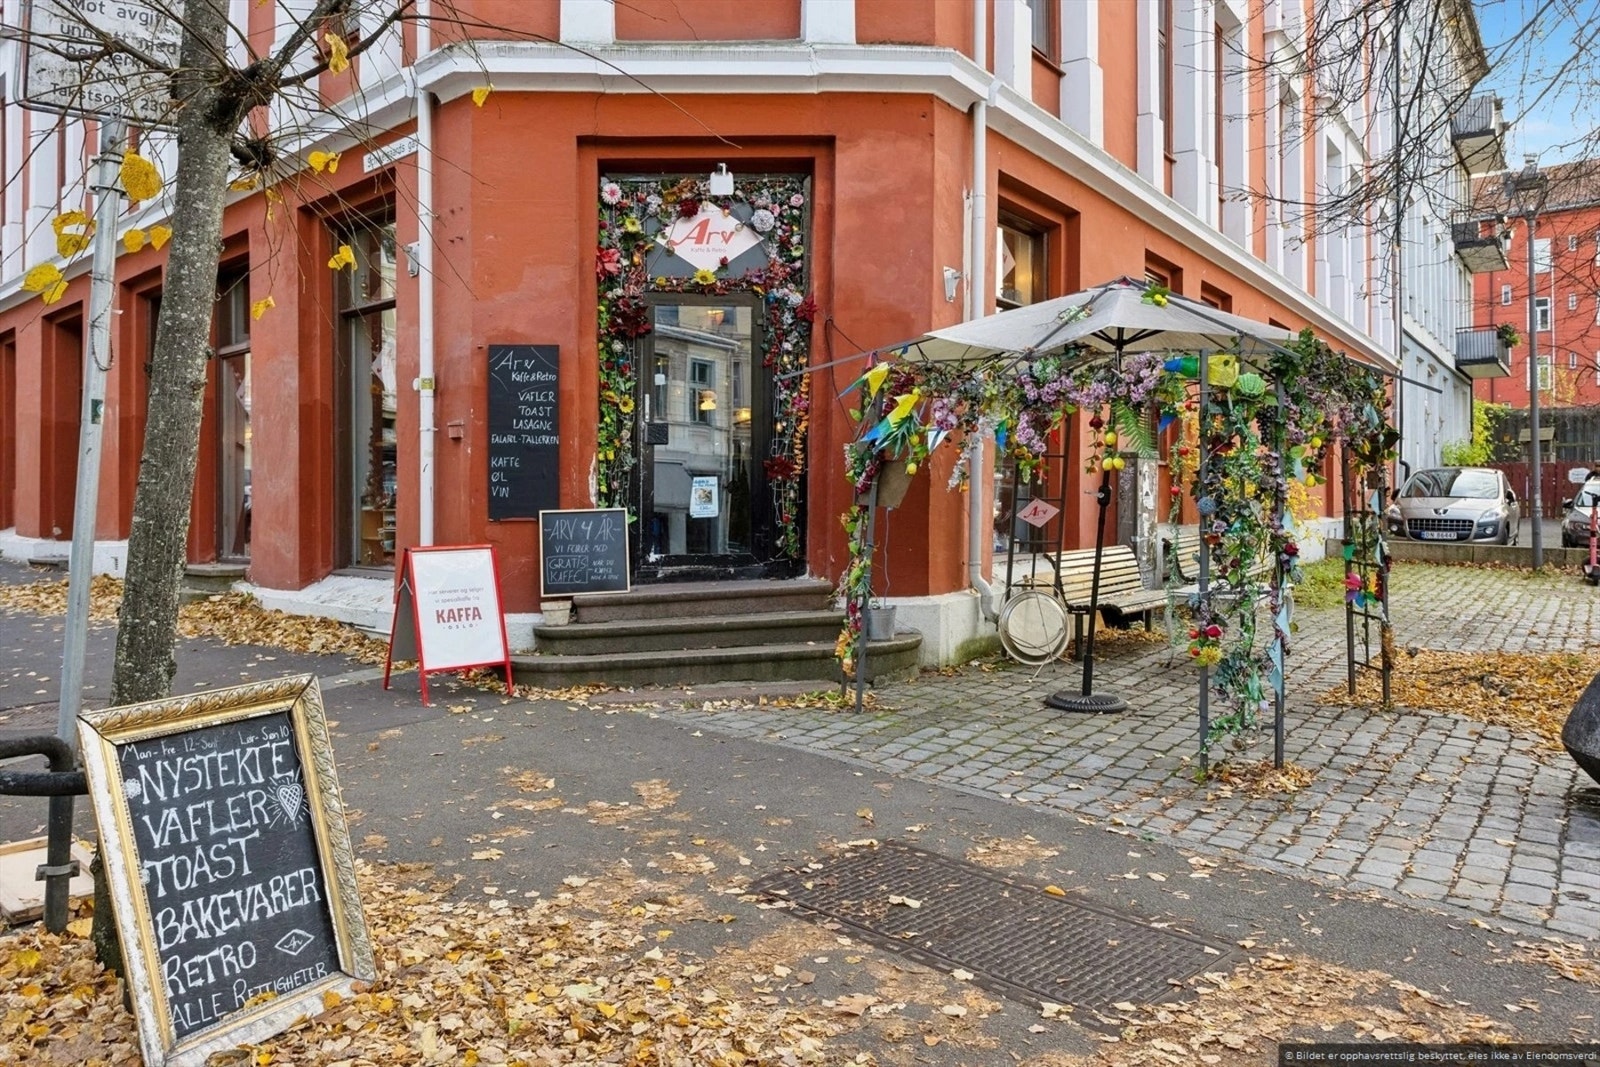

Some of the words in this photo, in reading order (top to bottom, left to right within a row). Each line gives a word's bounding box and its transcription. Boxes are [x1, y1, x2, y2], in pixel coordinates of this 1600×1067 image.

[667, 218, 735, 247] Arv
[495, 350, 535, 370] Arv
[518, 391, 556, 402] VAFLER
[518, 405, 553, 417] TOAST
[513, 418, 553, 431] LASAGNE
[491, 456, 520, 468] KAFFE
[491, 471, 508, 482] ØL
[491, 485, 510, 498] VIN
[580, 520, 593, 541] 4
[548, 556, 587, 570] GRATIS
[550, 570, 582, 583] KAFFE
[435, 606, 483, 624] KAFFA
[137, 739, 294, 805] NYSTEKTE
[142, 789, 270, 848] VAFLER
[143, 829, 260, 898] TOAST
[155, 867, 322, 951] BAKEVARER
[162, 941, 257, 998] RETRO
[172, 992, 229, 1030] ALLE
